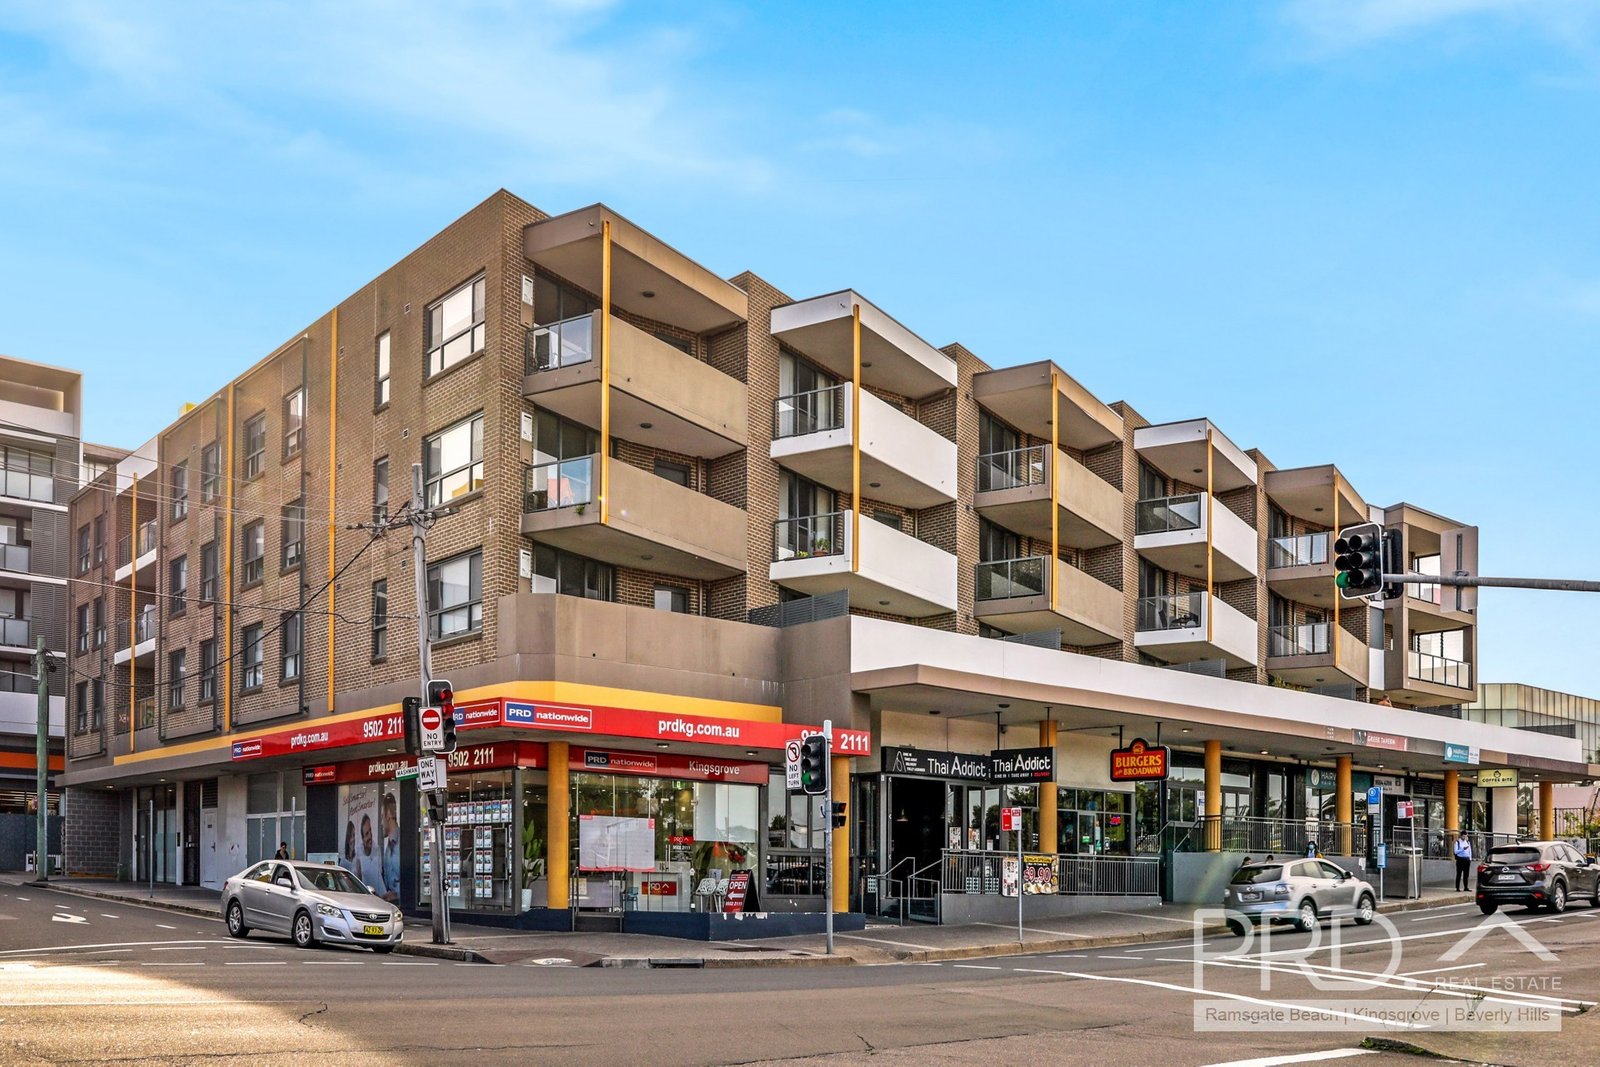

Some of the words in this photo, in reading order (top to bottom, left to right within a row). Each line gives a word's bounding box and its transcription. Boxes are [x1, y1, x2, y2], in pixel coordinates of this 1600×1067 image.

[466, 708, 498, 719] nationwide
[508, 708, 532, 718] PRD
[536, 711, 589, 723] nationwide
[363, 719, 384, 738] 9502
[387, 716, 404, 735] 211
[658, 719, 740, 738] prdkg.com.au
[290, 731, 329, 749] prdkg.com.au
[840, 733, 869, 752] 2111
[420, 760, 433, 769] ONE
[448, 750, 470, 768] 9502
[473, 747, 494, 765] 2111
[587, 755, 608, 764] PRD
[610, 758, 655, 768] nationwide
[992, 758, 1014, 772] Thai
[1014, 754, 1051, 771] Addict
[1115, 754, 1162, 768] BURGERS
[421, 769, 435, 778] WAY
[688, 760, 740, 776] Kingsgrove
[927, 758, 949, 775] Thai
[950, 755, 987, 777] Addict
[1123, 766, 1162, 776] BROADWAY
[729, 881, 747, 889] OPEN
